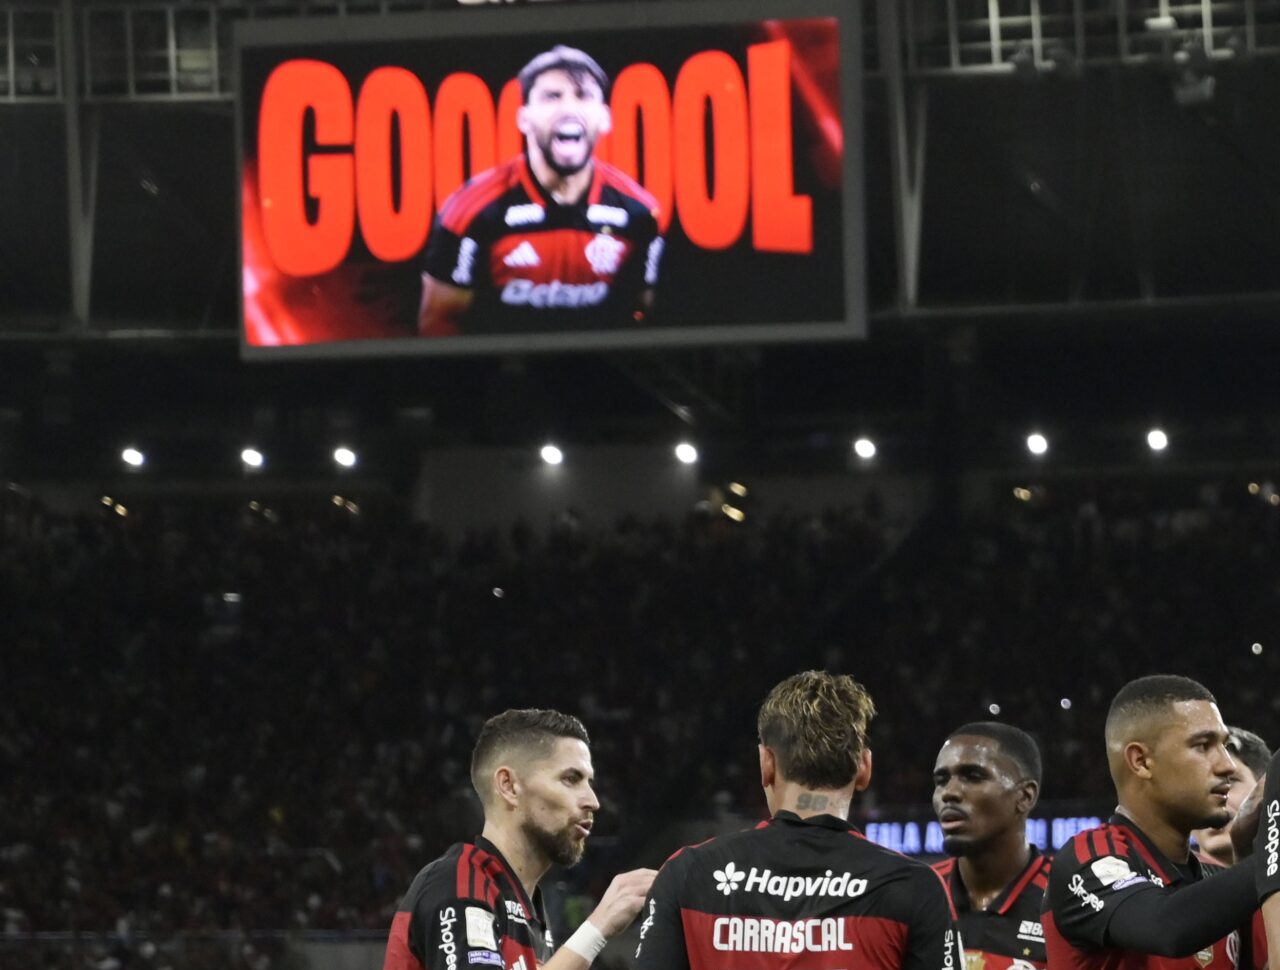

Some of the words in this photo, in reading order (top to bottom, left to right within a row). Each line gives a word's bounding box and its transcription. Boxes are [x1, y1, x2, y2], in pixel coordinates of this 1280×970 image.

[1264, 799, 1280, 877] Shopee
[745, 867, 868, 901] Hapvida
[713, 917, 854, 954] CARRASCAL
